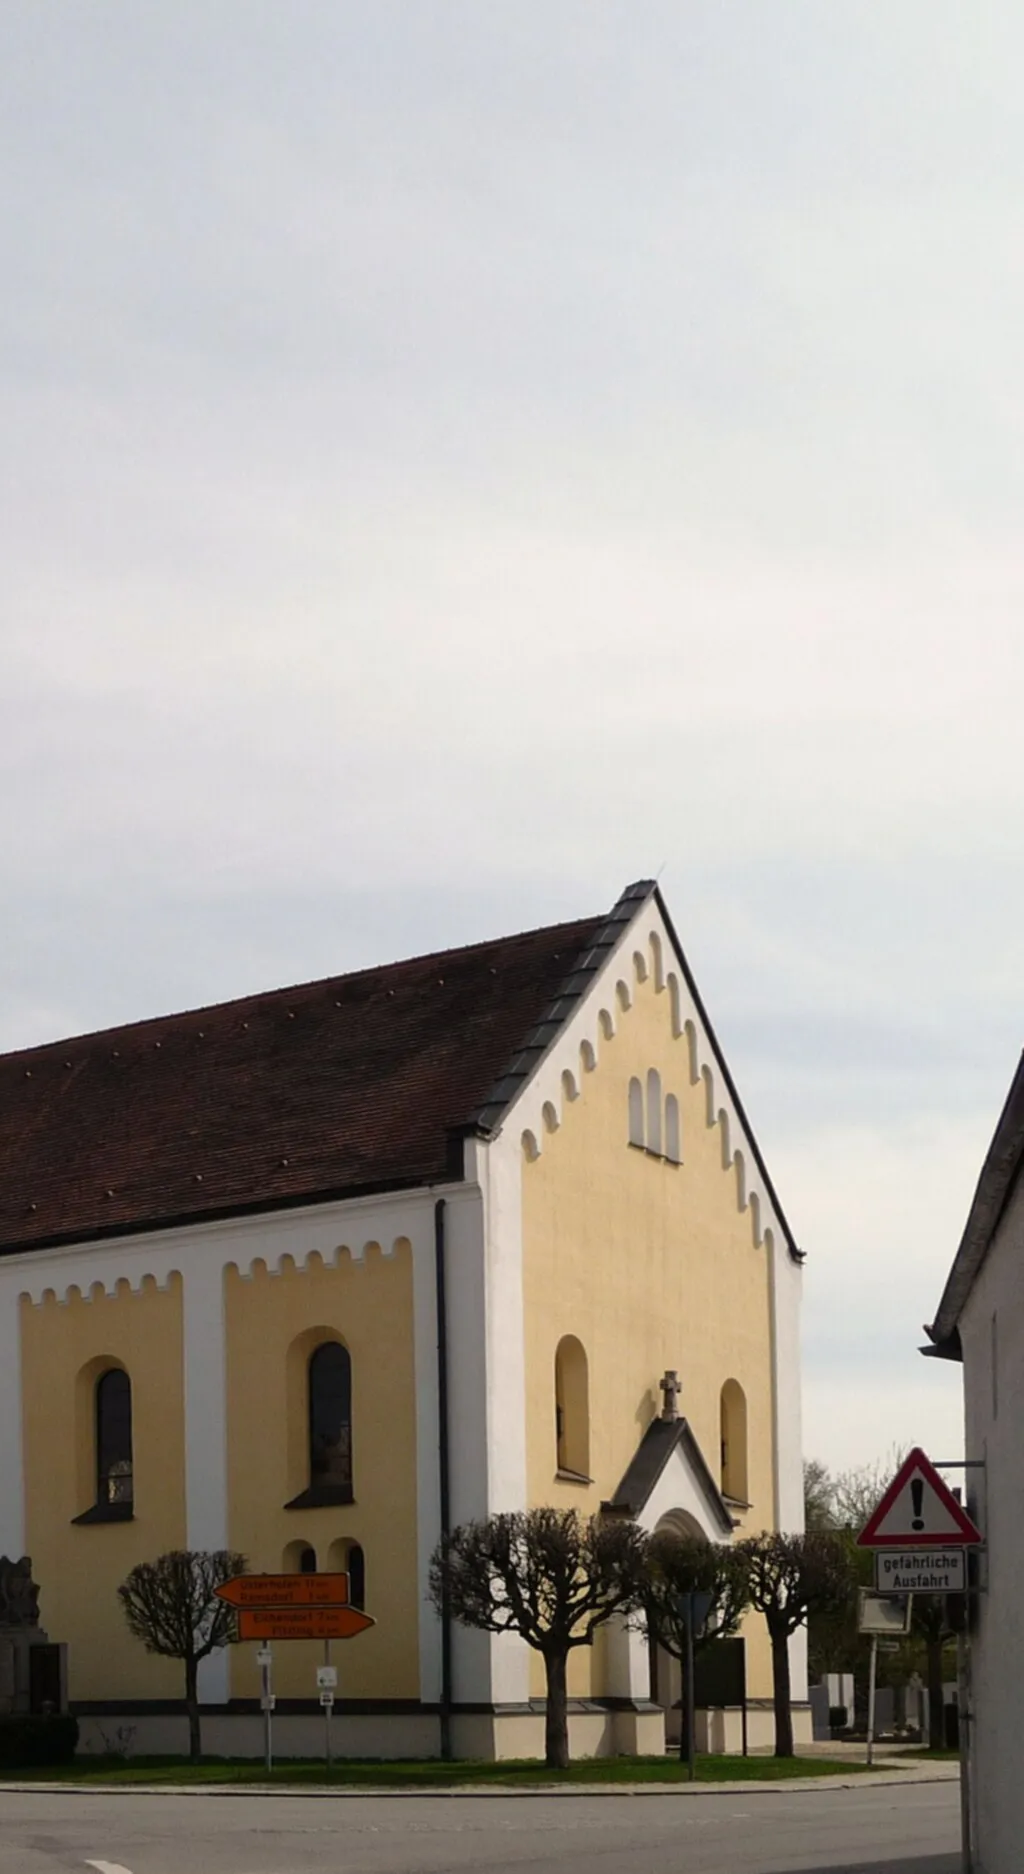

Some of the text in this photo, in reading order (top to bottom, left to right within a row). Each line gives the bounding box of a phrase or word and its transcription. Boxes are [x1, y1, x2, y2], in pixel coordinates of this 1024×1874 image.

[884, 1554, 958, 1573] gefährliche
[893, 1573, 949, 1588] Ausfahrt
[253, 1611, 312, 1623] Eichendorf
